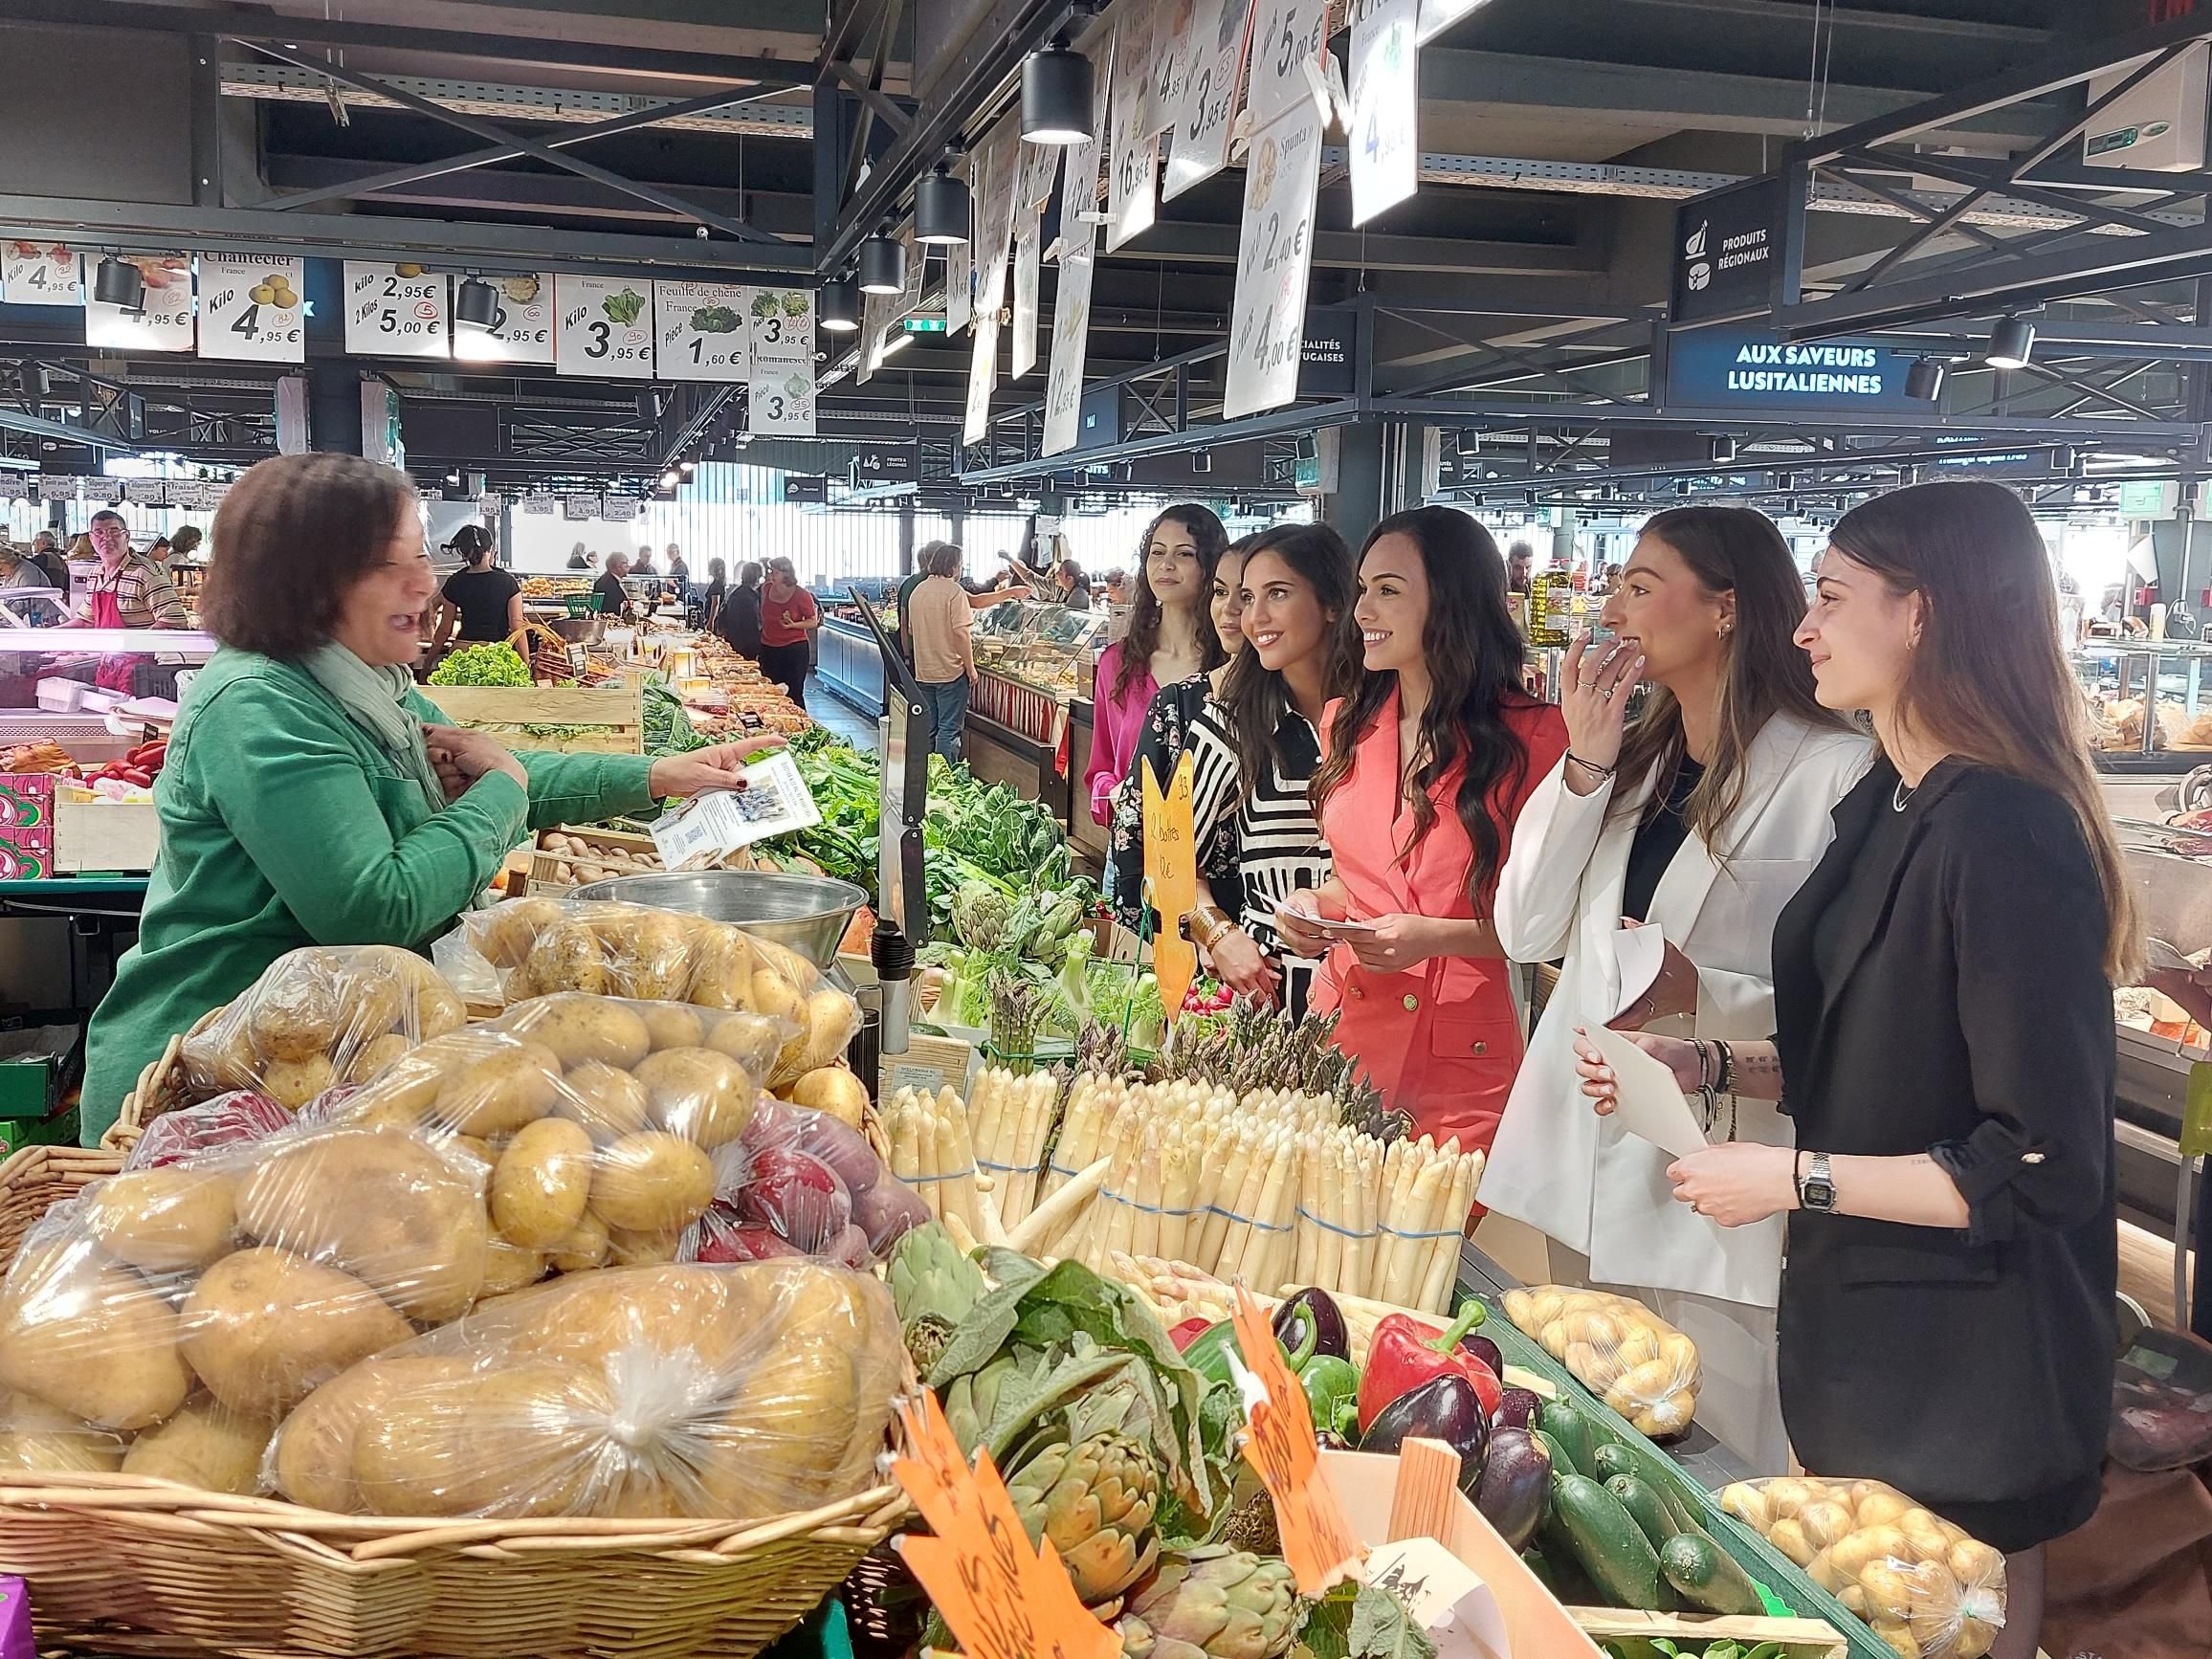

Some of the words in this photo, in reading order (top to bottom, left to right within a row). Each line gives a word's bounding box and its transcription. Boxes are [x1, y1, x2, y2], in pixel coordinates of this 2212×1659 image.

[1190, 67, 1219, 142] 3,95
[1118, 148, 1143, 204] 16,95
[1263, 211, 1292, 275] 2,40
[1294, 219, 1307, 256] €
[1722, 229, 1767, 253] PRODUITS
[221, 266, 246, 276] France
[1717, 246, 1769, 271] RÉGIONAUX
[7, 263, 24, 284] Kilo
[28, 265, 64, 293] 4,95
[67, 280, 77, 292] €
[354, 273, 374, 294] kilo
[581, 280, 605, 289] France
[209, 288, 234, 315] Kilo
[697, 286, 710, 298] de
[174, 311, 188, 326] €
[564, 304, 588, 332] Kilo
[665, 299, 697, 313] France
[231, 303, 282, 344] 4,95
[286, 328, 301, 343] €
[379, 308, 422, 337] 5,00
[427, 321, 440, 335] €
[534, 328, 548, 343] €
[664, 321, 683, 348] Pièce
[763, 318, 797, 345] 3,95
[800, 335, 809, 345] €
[584, 321, 633, 363] 3,95
[637, 346, 652, 361] €
[688, 337, 725, 368] 1,60
[729, 351, 742, 365] €
[1253, 303, 1284, 376] 4,00
[1287, 325, 1298, 362] €
[1736, 344, 1784, 365] AUX
[1784, 346, 1877, 368] SAVEURS
[1728, 370, 1883, 394] LUSITALIENNES
[766, 396, 800, 423] 3,95
[802, 409, 811, 421] €
